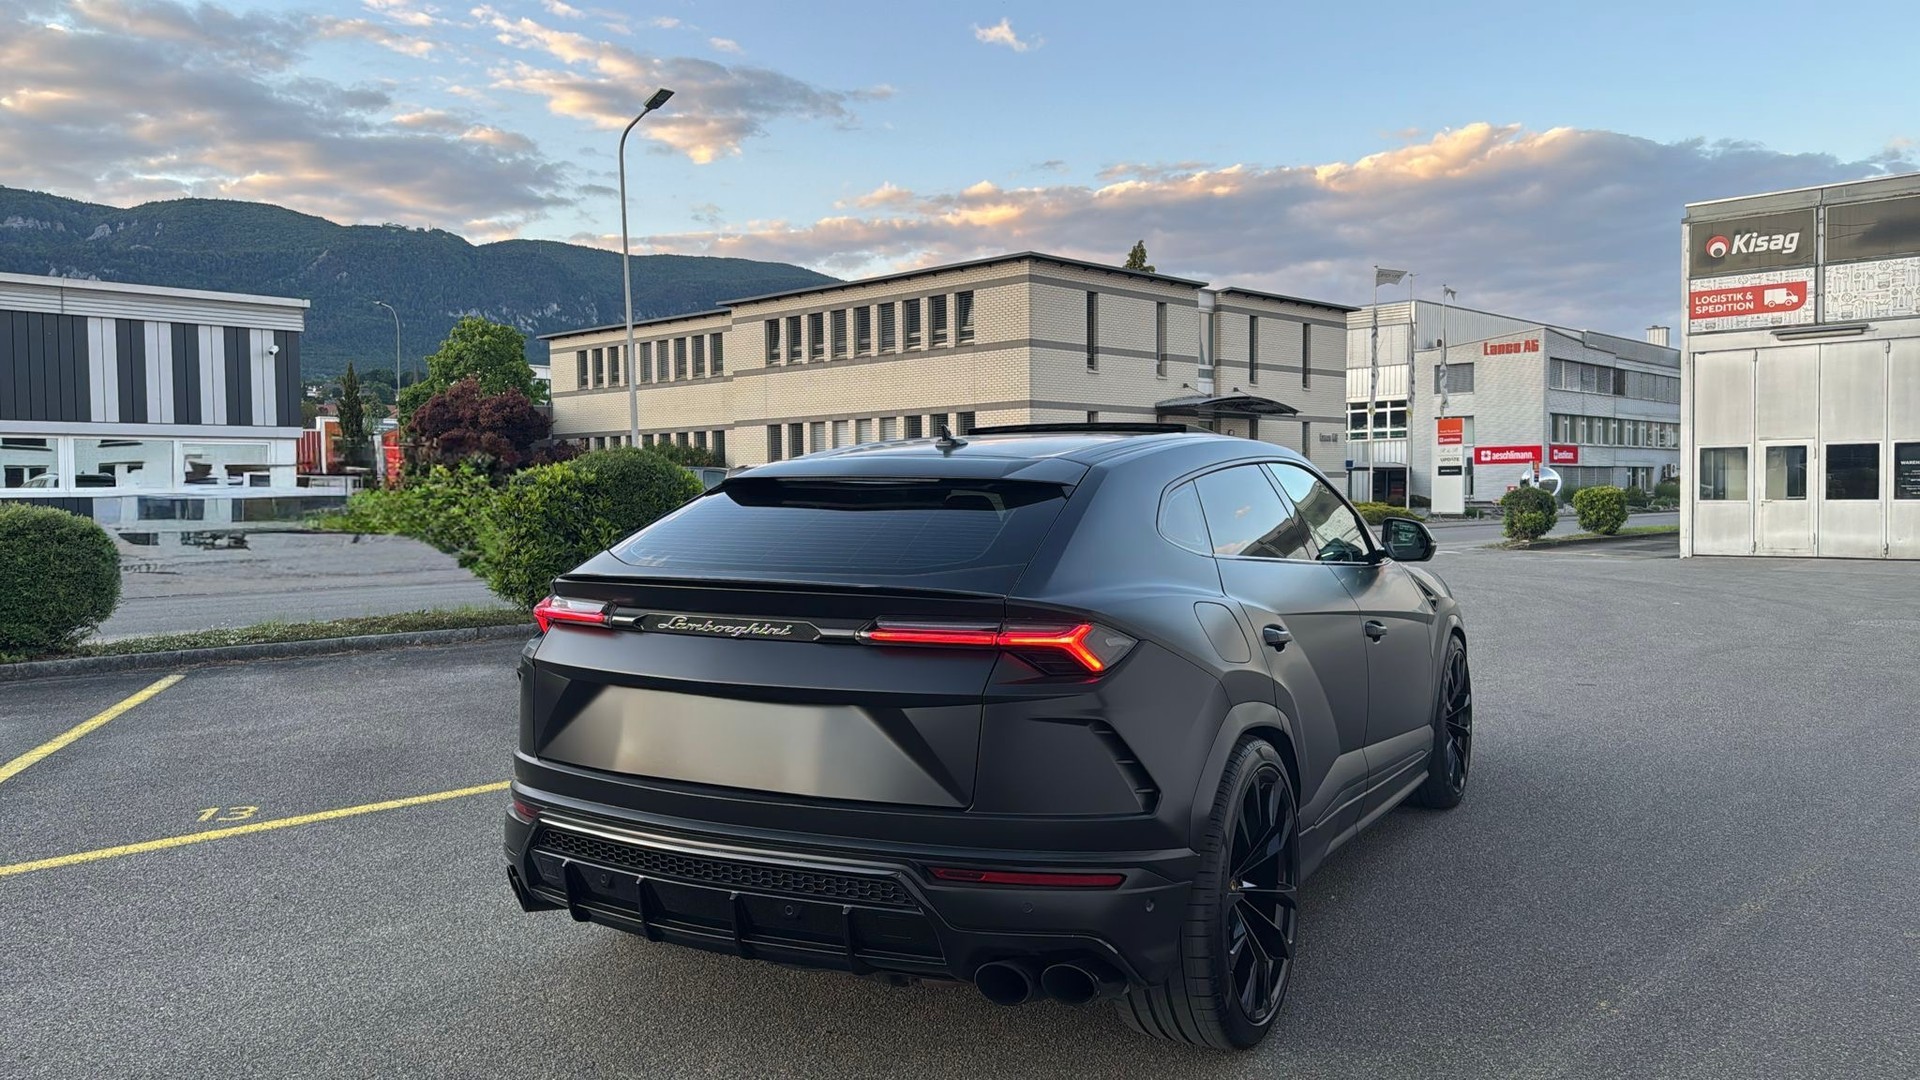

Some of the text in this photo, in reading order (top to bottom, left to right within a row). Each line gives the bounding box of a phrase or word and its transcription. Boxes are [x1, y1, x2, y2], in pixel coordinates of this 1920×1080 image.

[1731, 232, 1800, 254] Kisag
[1695, 291, 1753, 304] LOGISTIK &
[1695, 301, 1754, 314] SPEDITION
[1484, 339, 1539, 355] Lanco AG
[658, 616, 792, 636] Lamborghini
[196, 805, 260, 822] 13
